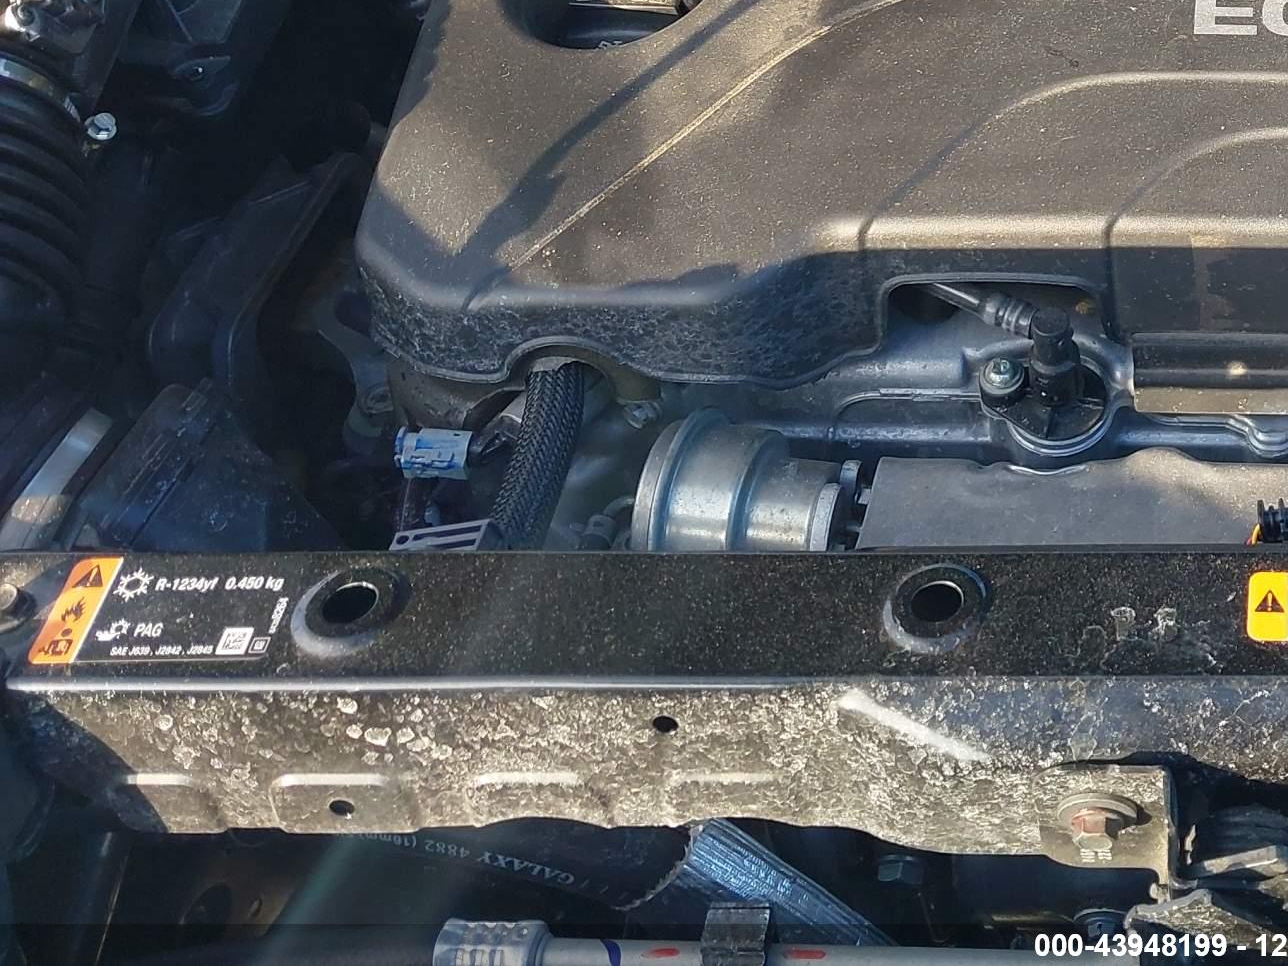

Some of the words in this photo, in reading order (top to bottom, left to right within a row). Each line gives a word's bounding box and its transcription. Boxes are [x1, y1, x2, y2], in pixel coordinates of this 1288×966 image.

[155, 577, 219, 593] R-1234yf
[225, 576, 264, 590] 0.450
[265, 576, 285, 592] kg
[133, 622, 164, 637] PAG
[425, 838, 470, 859] 4882
[476, 850, 575, 884] GALAXY
